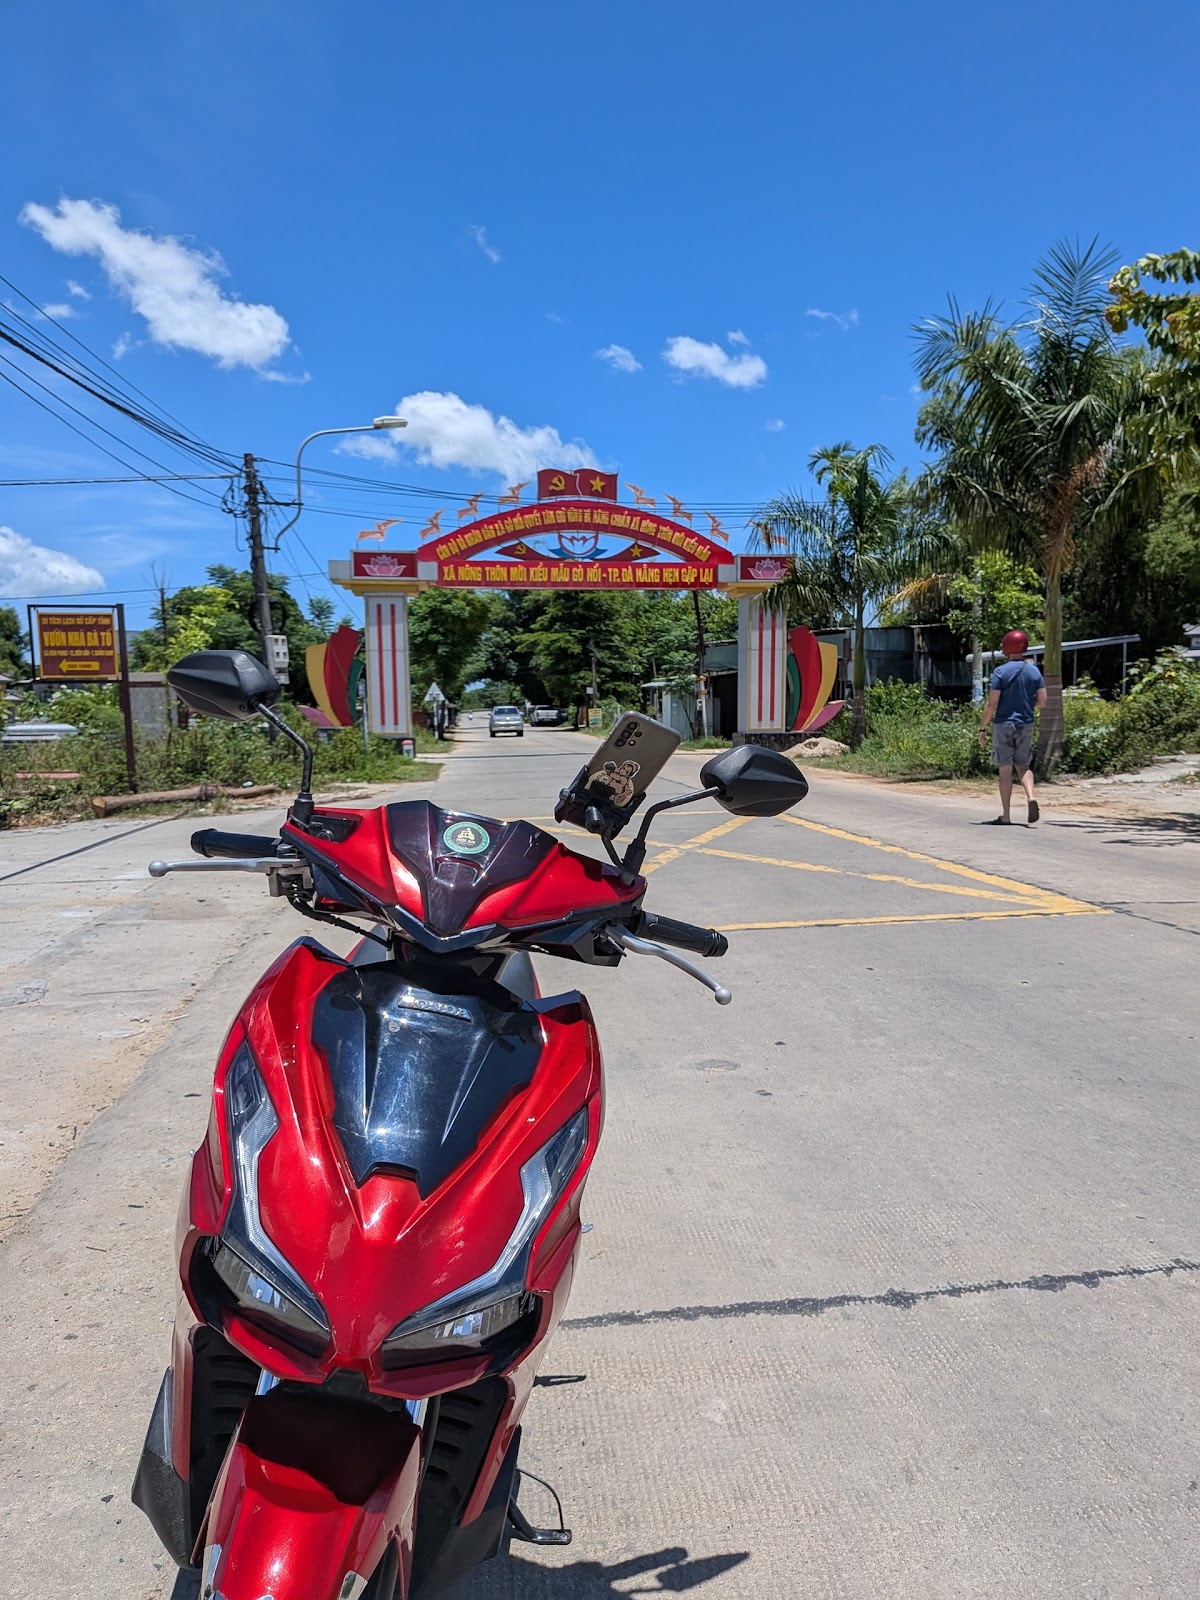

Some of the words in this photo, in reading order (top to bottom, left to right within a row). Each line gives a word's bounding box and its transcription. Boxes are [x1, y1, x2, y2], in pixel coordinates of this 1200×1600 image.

[523, 509, 542, 529] QUYẾT
[611, 511, 631, 528] CHUẨN
[443, 564, 456, 580] XÃ
[458, 564, 482, 581] NÔNG
[485, 564, 507, 581] THÔN
[510, 564, 526, 582] MỚI
[529, 562, 548, 582] KIỂU
[551, 563, 570, 582] MẪU
[572, 565, 583, 582] GÒ
[608, 568, 620, 582] TP.
[621, 565, 633, 582] ĐÀ
[635, 564, 660, 583] NẴNG
[663, 568, 679, 585] HẸN
[681, 566, 697, 585] GẶP
[700, 568, 713, 585] LẠI
[68, 629, 85, 646] NHÀ
[86, 629, 99, 646] BÀ
